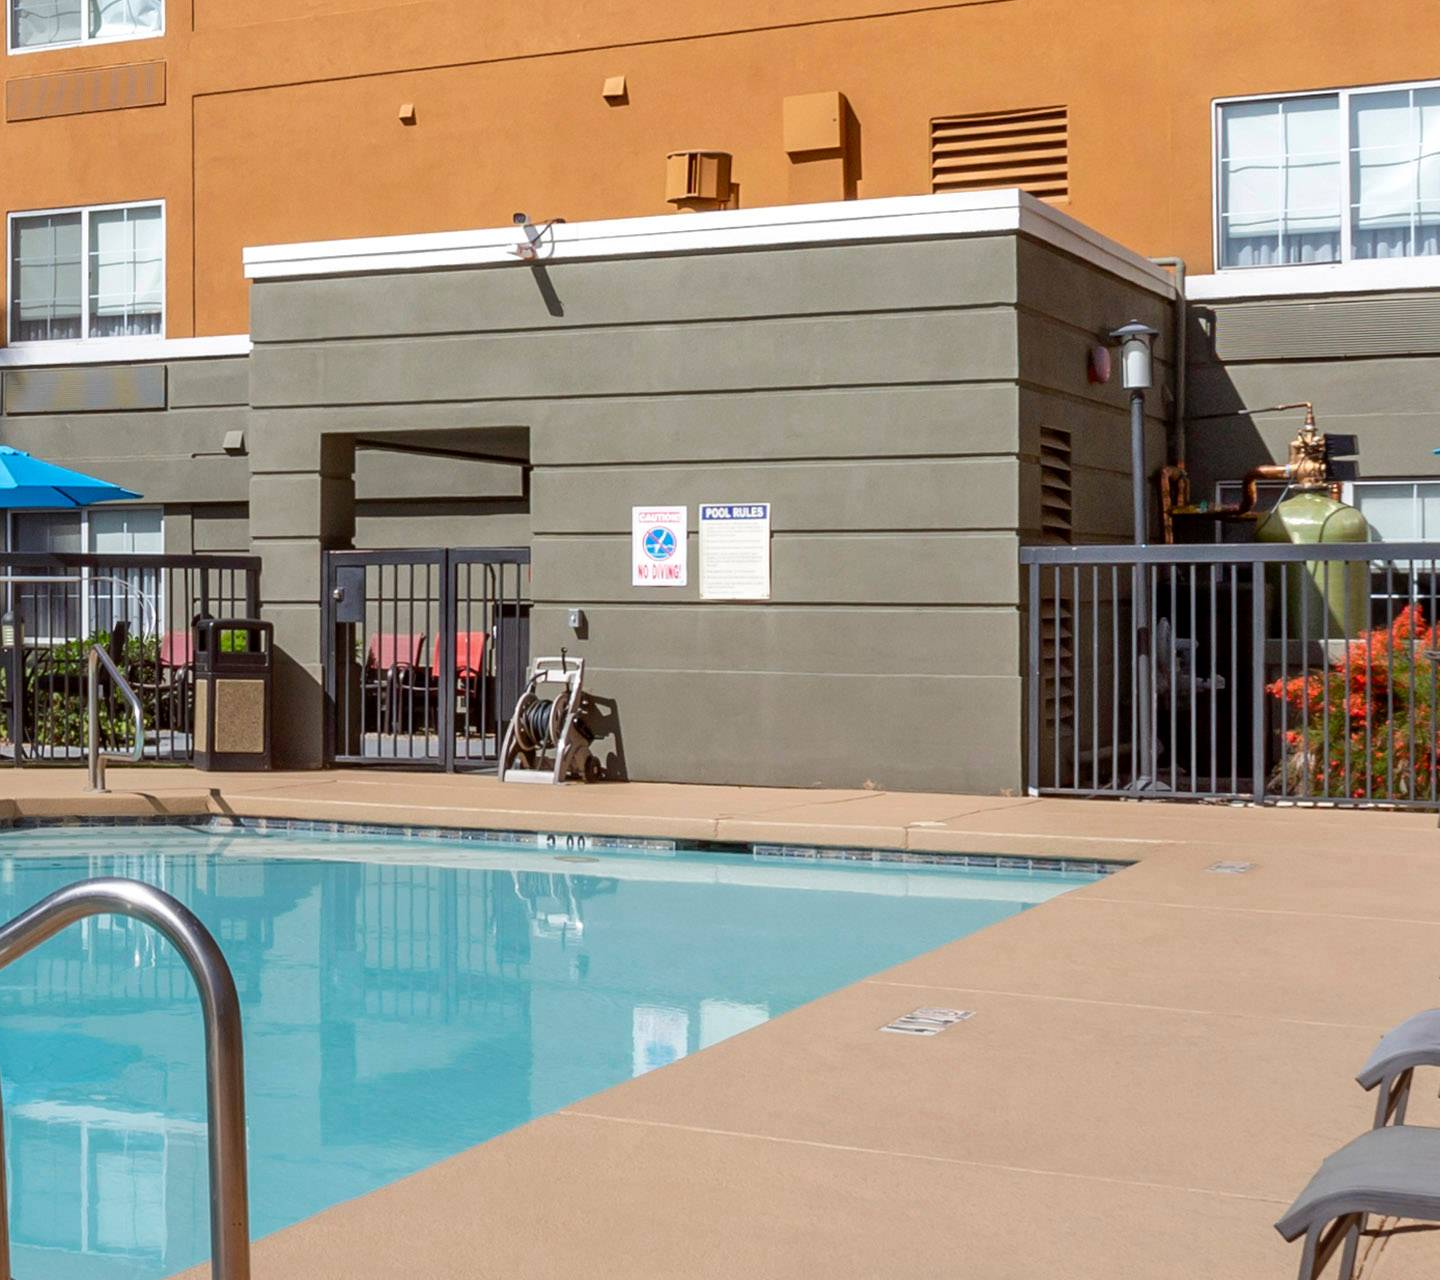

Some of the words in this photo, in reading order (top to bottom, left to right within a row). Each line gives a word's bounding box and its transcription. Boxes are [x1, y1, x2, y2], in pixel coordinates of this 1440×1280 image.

[705, 507, 731, 519] POOL
[733, 506, 764, 518] RULES
[638, 564, 649, 579] NO
[652, 564, 681, 579] DIVING!
